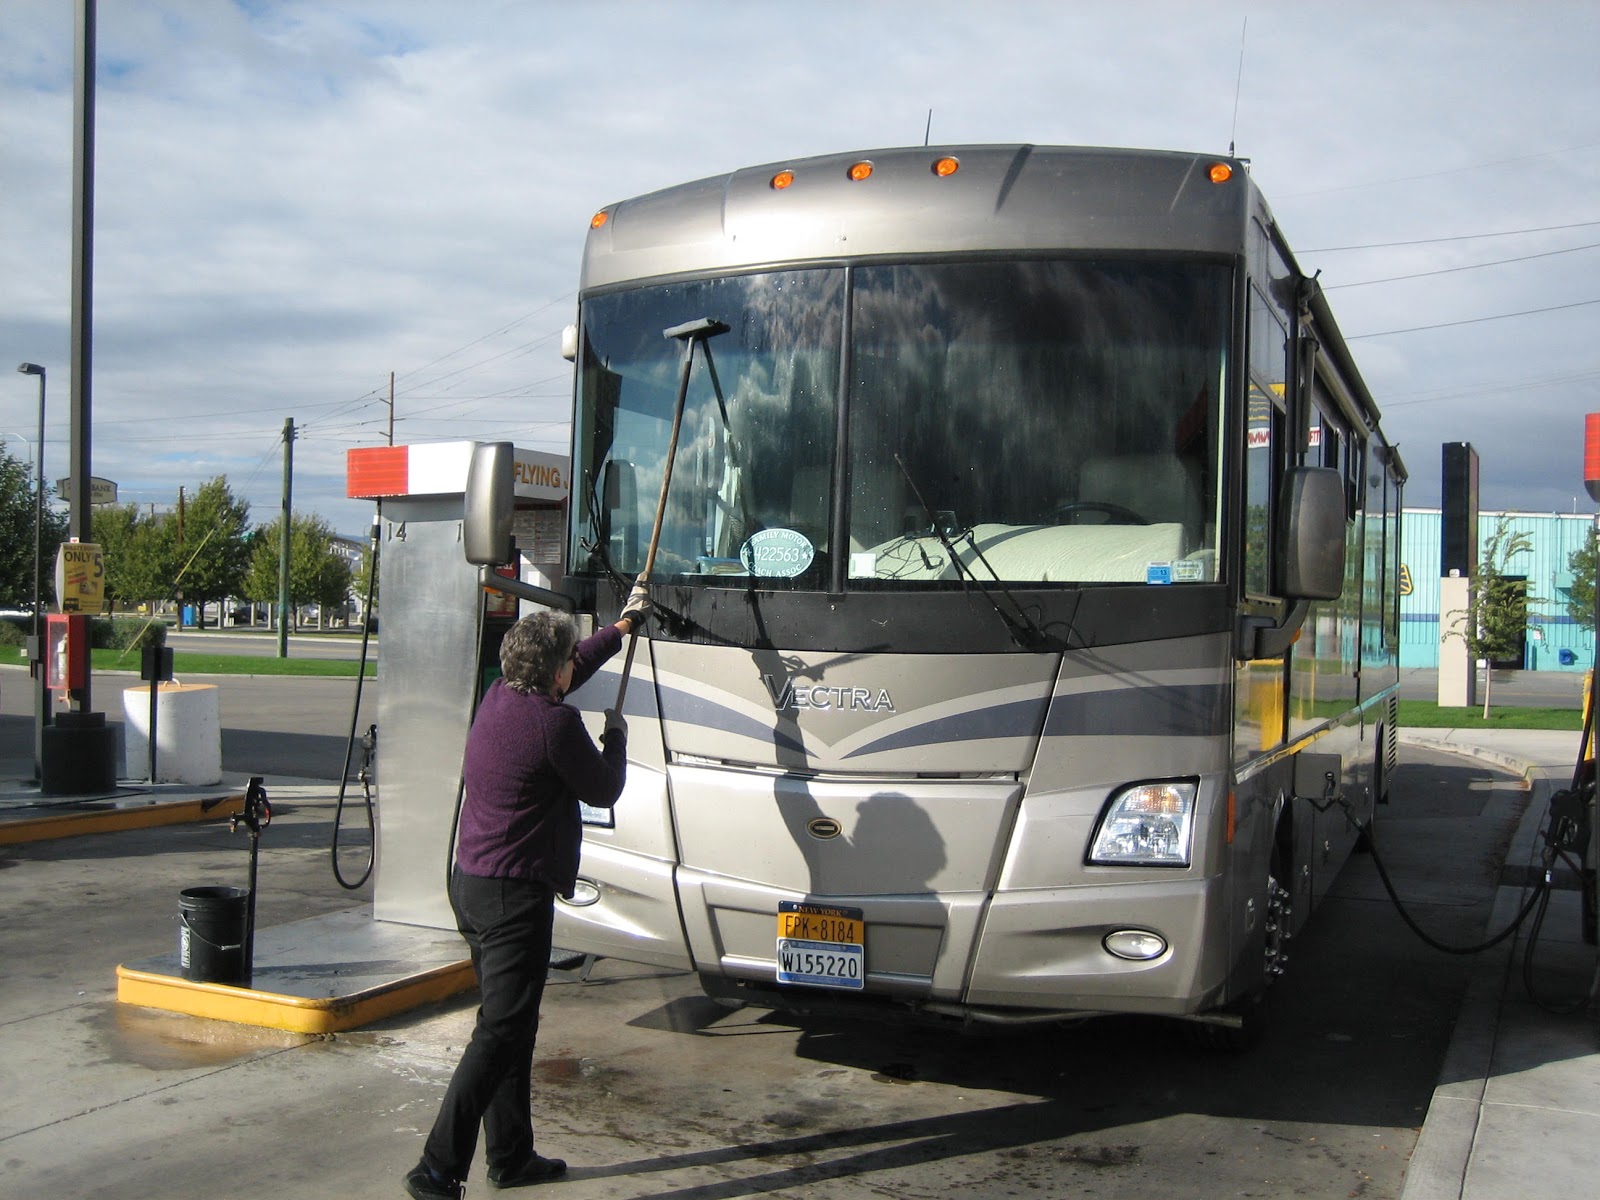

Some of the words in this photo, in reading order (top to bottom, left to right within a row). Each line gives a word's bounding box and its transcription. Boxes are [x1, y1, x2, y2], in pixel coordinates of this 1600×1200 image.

[514, 462, 561, 488] FLYING
[388, 521, 407, 542] 14
[751, 531, 779, 546] FAMILY
[781, 532, 807, 548] MOTOR
[65, 551, 91, 562] ONLY
[754, 547, 799, 562] 422563
[749, 562, 772, 577] COACH
[763, 674, 896, 712] VECTRA
[798, 905, 820, 914] NEW
[820, 908, 842, 917] YORK
[782, 952, 857, 978] W155220
